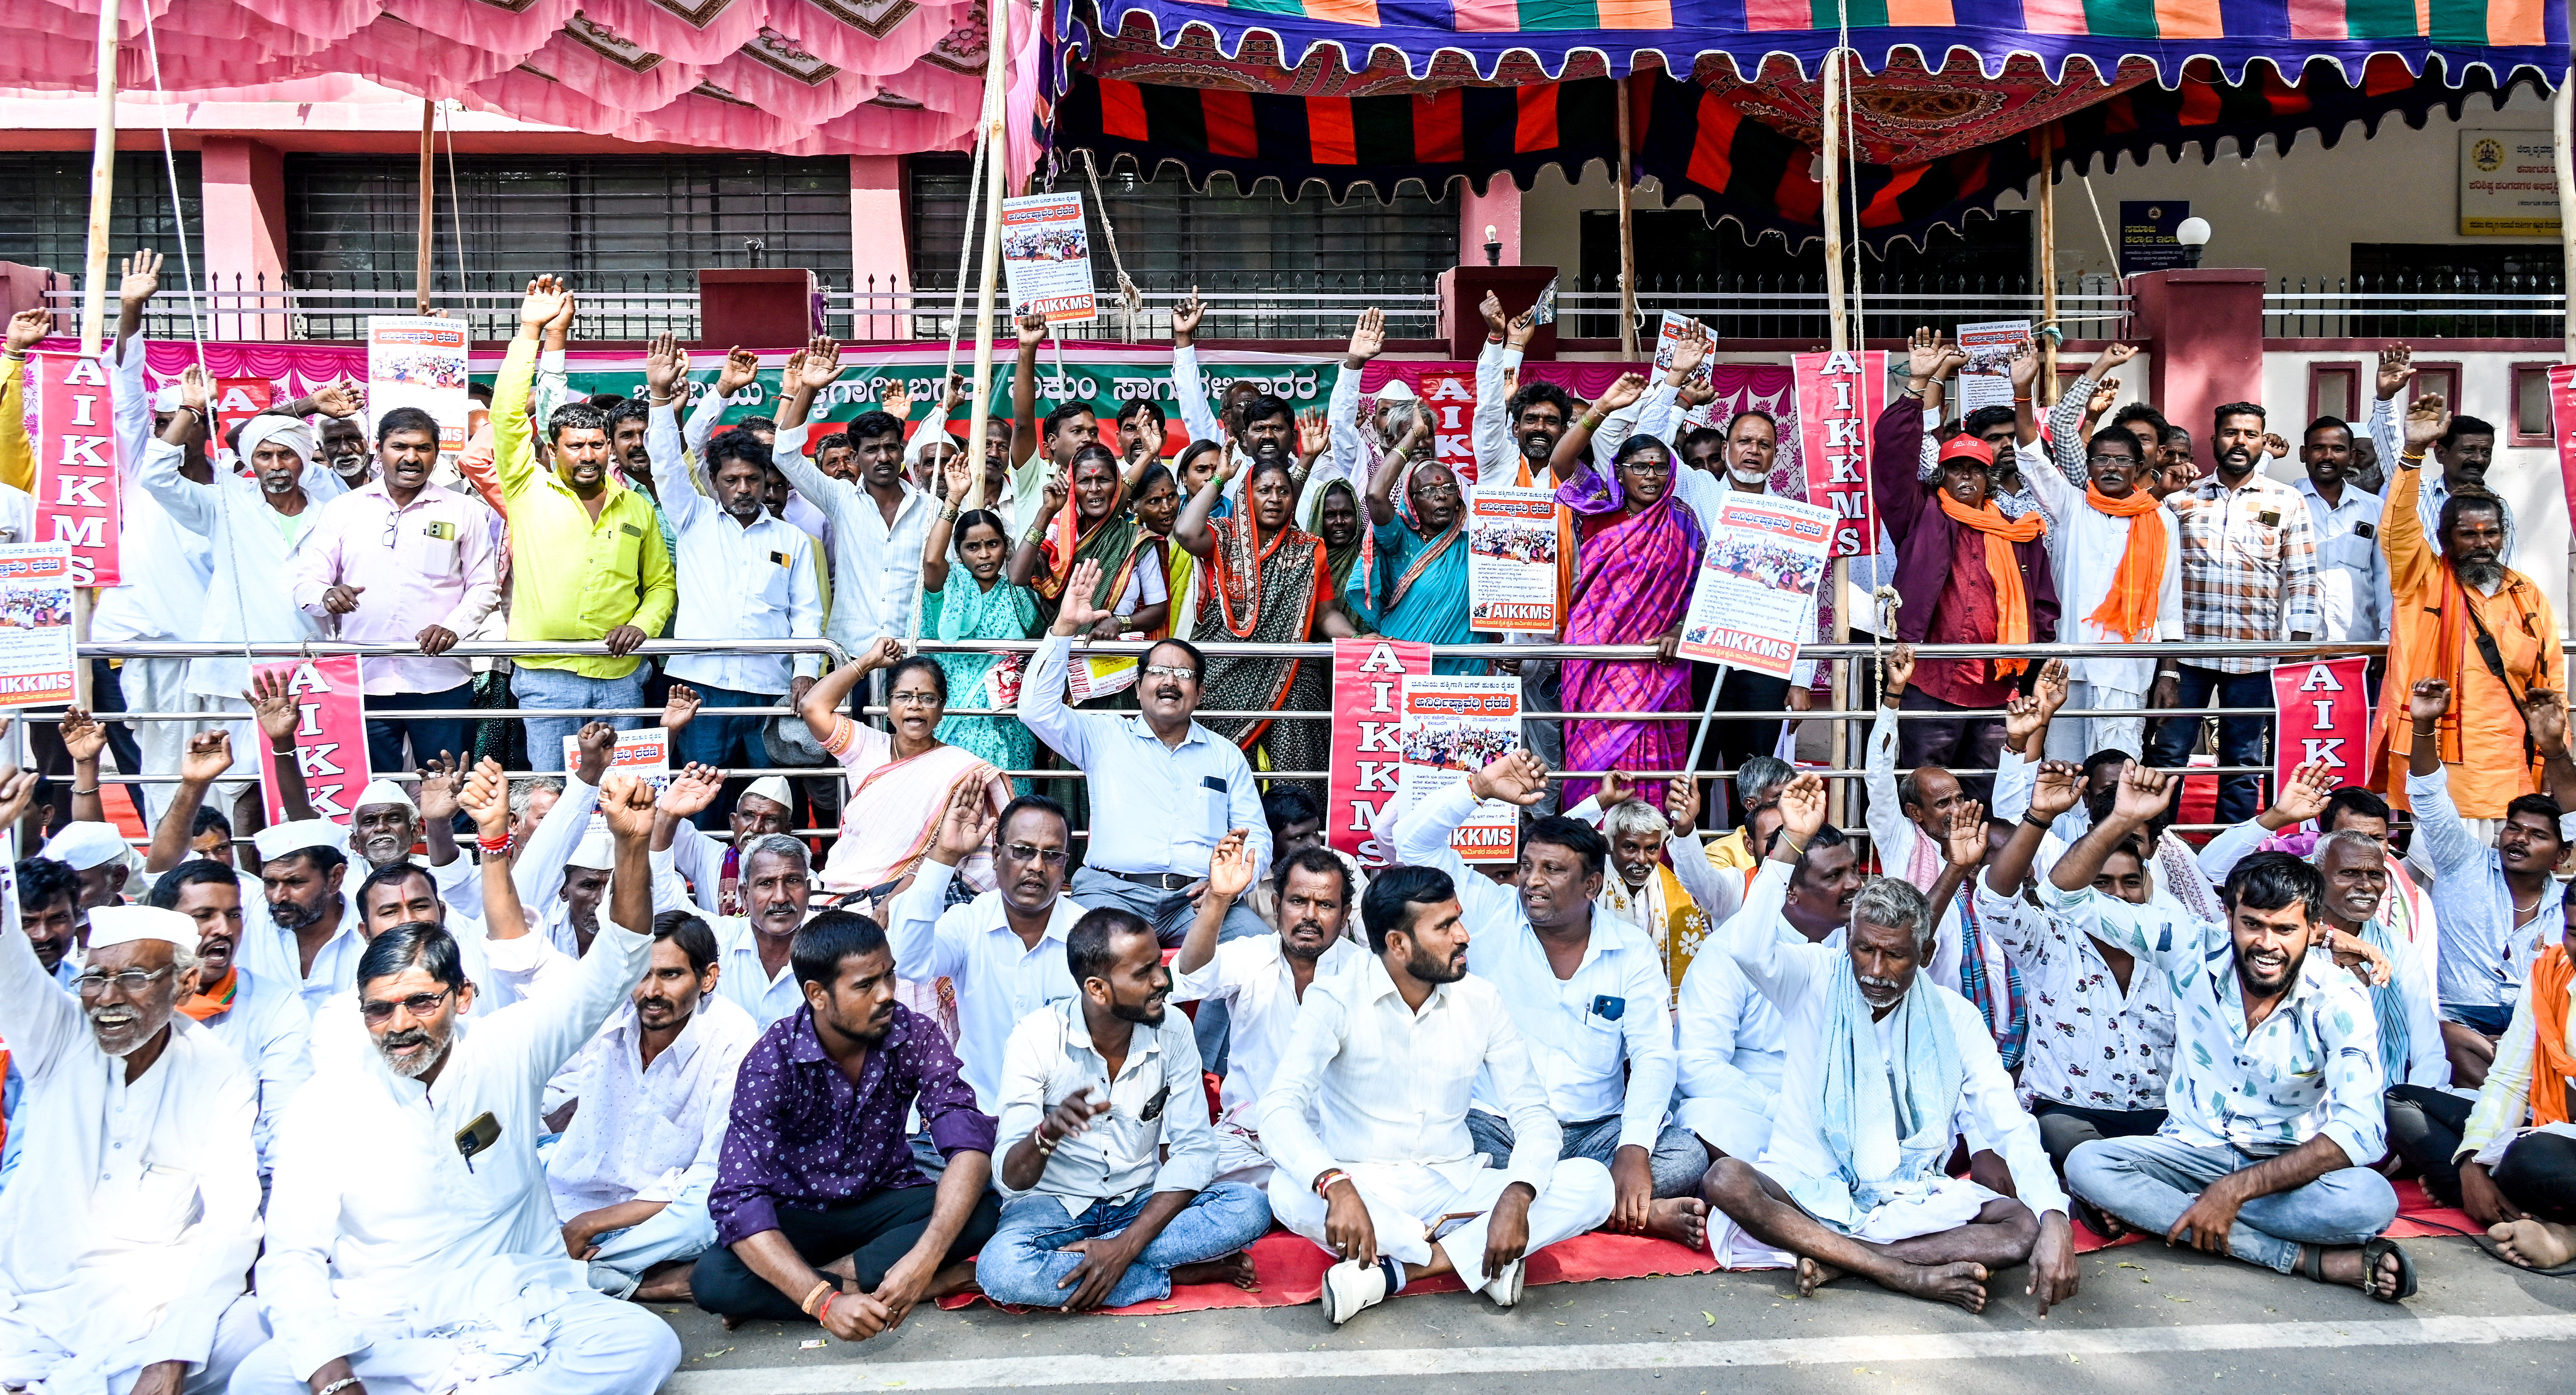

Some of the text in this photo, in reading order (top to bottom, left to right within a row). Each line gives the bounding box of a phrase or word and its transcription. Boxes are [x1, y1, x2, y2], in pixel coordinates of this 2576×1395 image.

[2125, 235, 2153, 247] ಕಲ್ಯಾಣ
[1035, 296, 1092, 314] AIKKMS
[1820, 351, 1866, 555] AIKKMS
[50, 358, 108, 586] AIKKMS
[1532, 503, 1550, 515] ಧರಣಿ
[1795, 522, 1822, 535] ಧರಣಿ
[1493, 604, 1552, 620] AIKKMS
[1711, 629, 1792, 660] AIKKMS
[1440, 682, 1462, 690] ಹಕ್ಕಿಗಾಗಿ
[1501, 682, 1515, 691] ರೈತರ
[1485, 697, 1510, 710] ಧರಣಿ
[635, 746, 658, 759] ಧರಣಿ
[1450, 828, 1512, 846] KKMS
